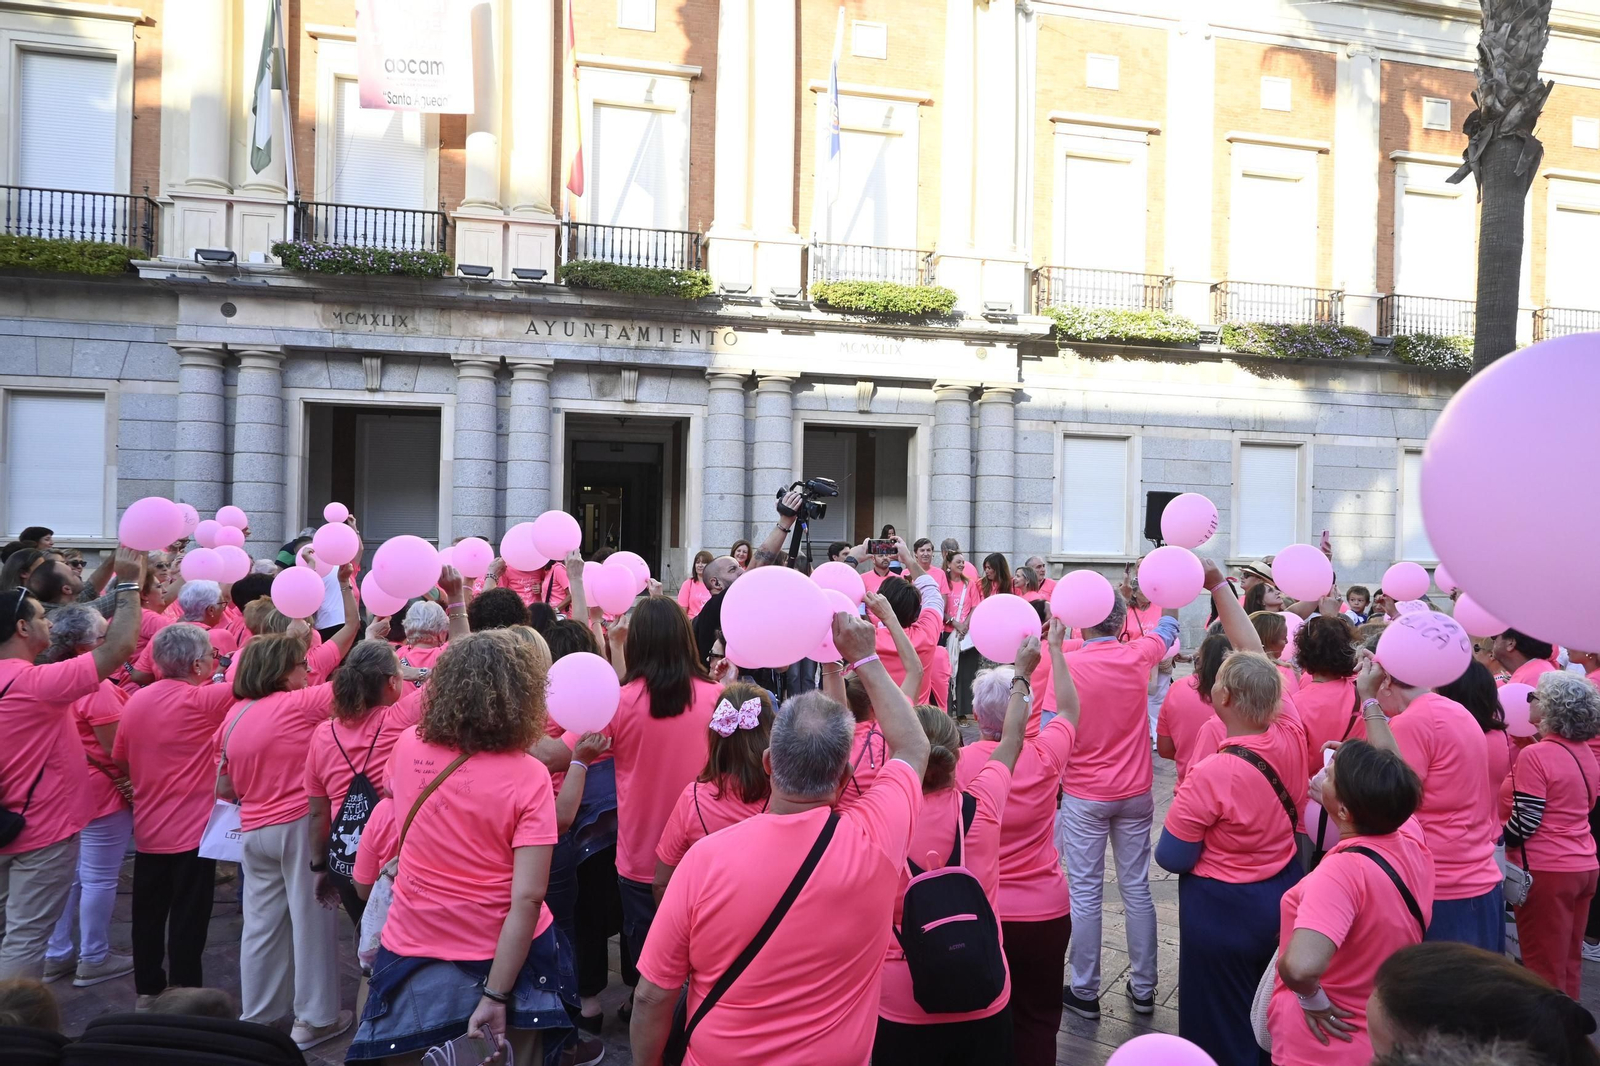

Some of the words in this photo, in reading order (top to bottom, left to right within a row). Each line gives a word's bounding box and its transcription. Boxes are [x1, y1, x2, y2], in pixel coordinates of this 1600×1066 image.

[333, 311, 409, 328] MCMXLIX
[525, 320, 738, 346] AYUNTAMIENTO
[839, 341, 903, 355] MCMXLIX
